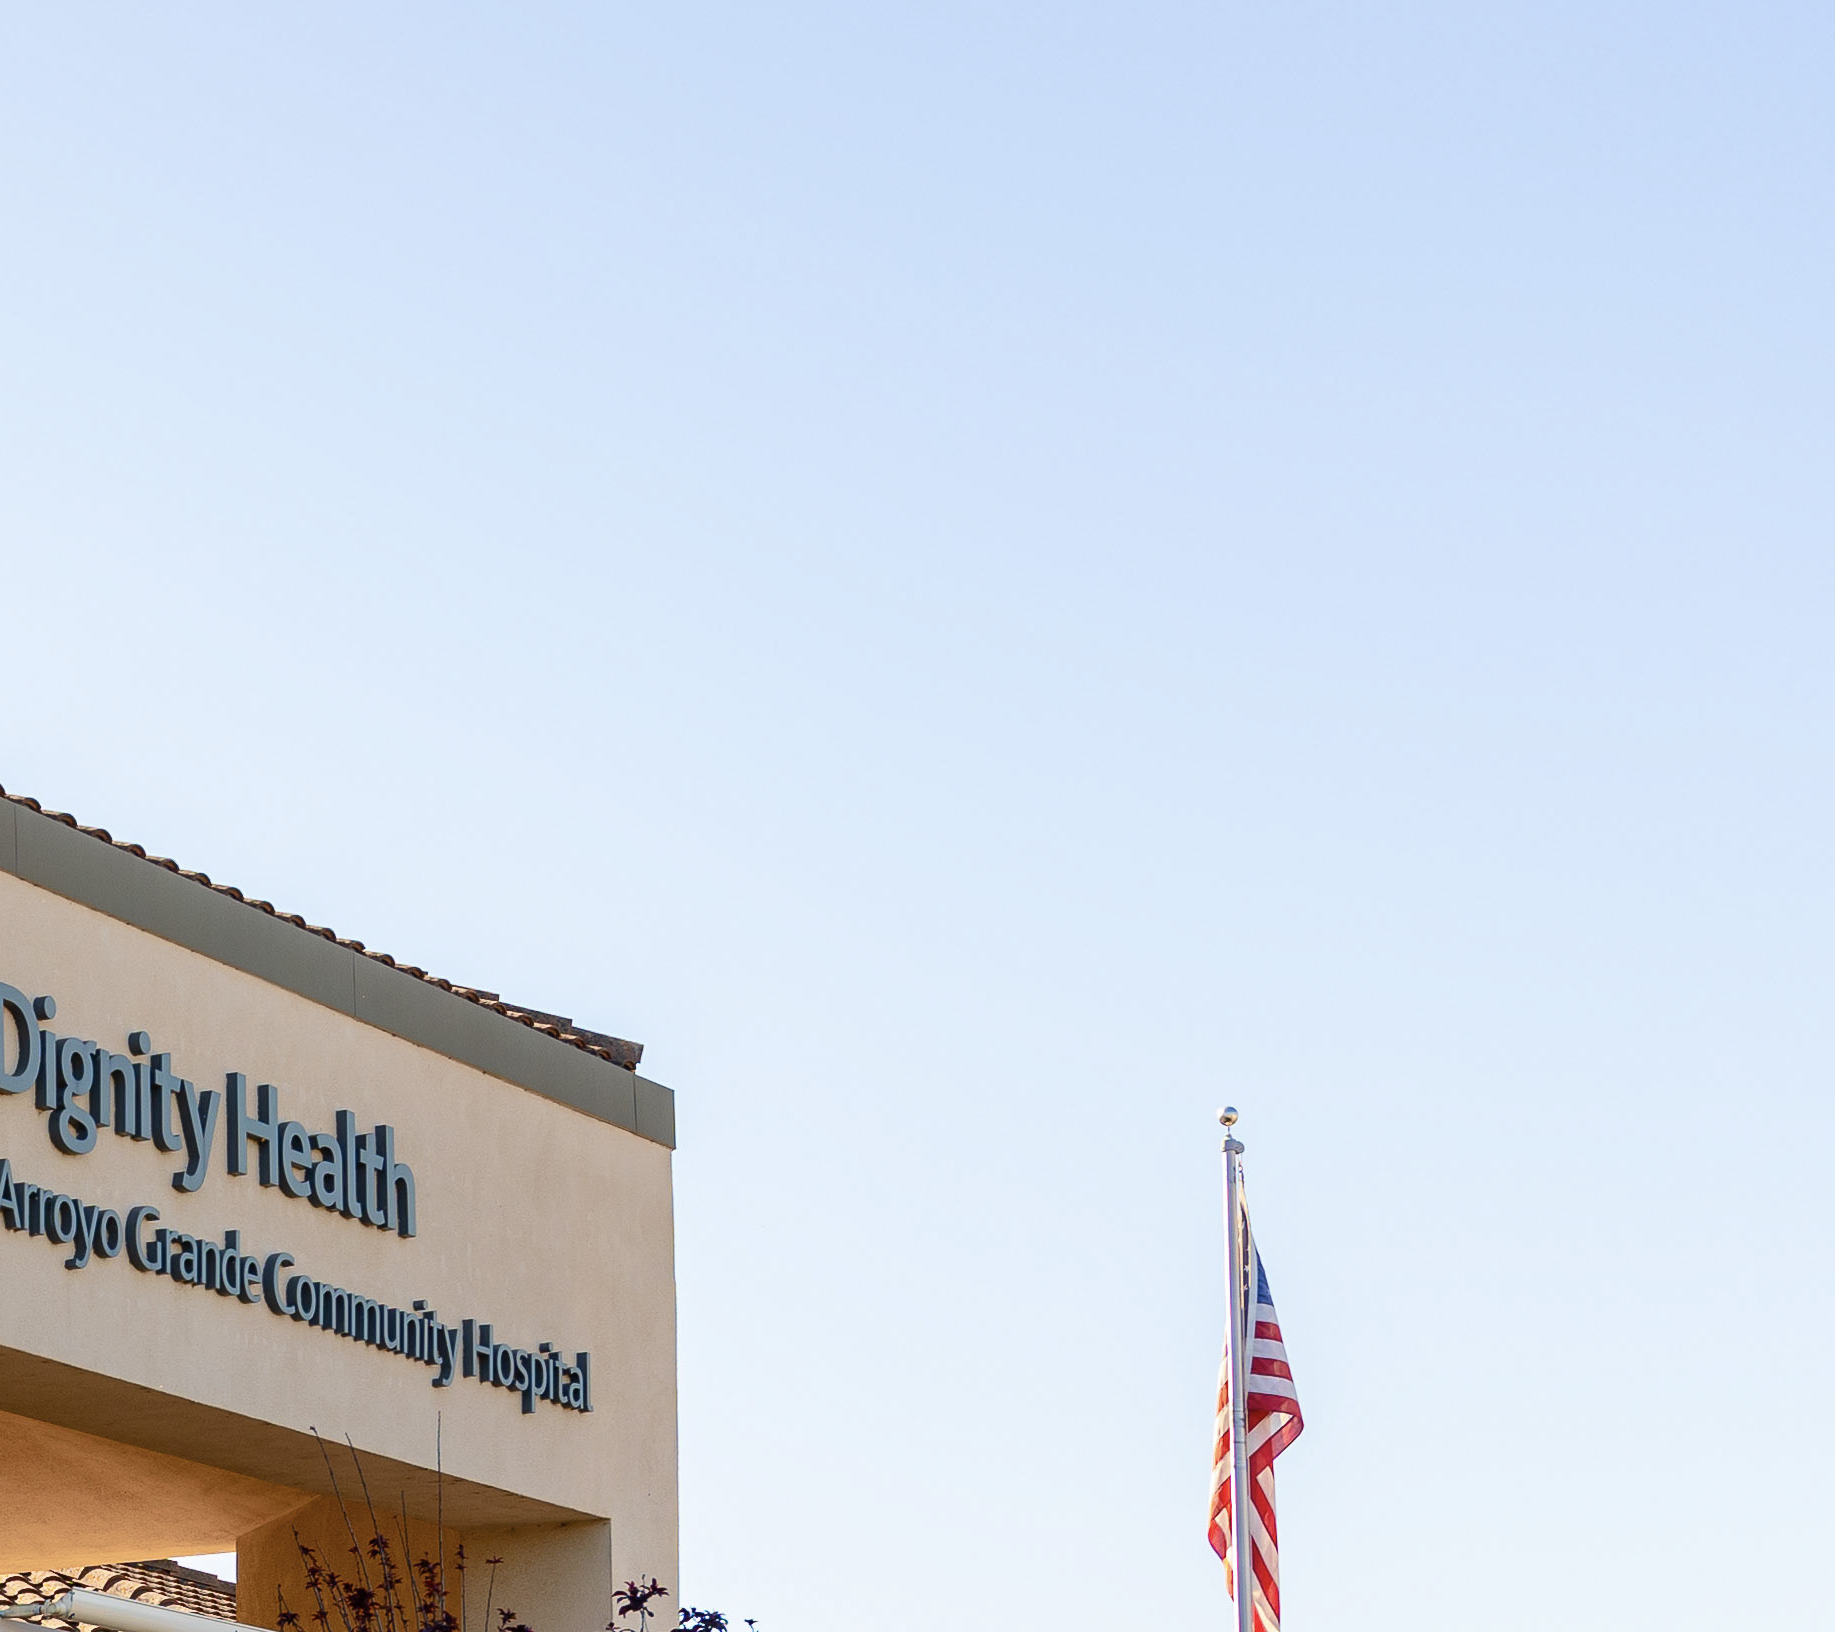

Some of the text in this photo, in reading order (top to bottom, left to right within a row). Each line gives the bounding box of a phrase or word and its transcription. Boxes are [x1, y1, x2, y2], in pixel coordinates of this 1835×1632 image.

[226, 1072, 417, 1238] Health
[125, 1205, 261, 1304] Grande
[263, 1252, 460, 1387] Community
[462, 1319, 593, 1414] Hospital
